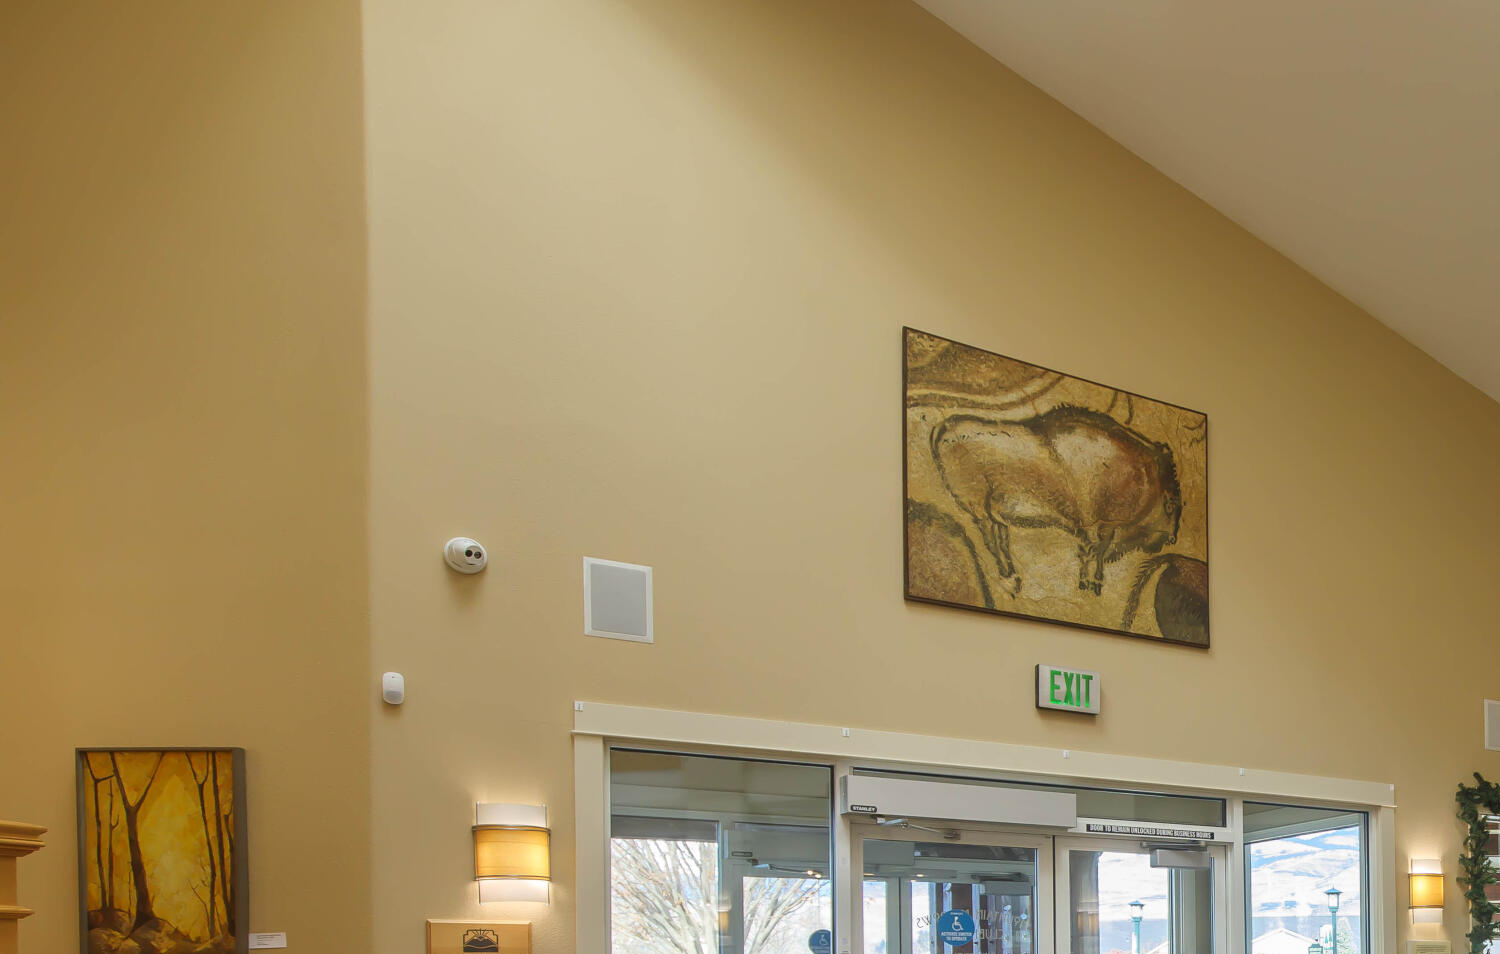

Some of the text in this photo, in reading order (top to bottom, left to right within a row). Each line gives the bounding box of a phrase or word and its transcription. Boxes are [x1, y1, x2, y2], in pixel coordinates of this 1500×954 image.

[1050, 669, 1093, 708] EXIT
[1130, 826, 1156, 835] UNLOCKED
[1174, 829, 1196, 837] BUSINESS
